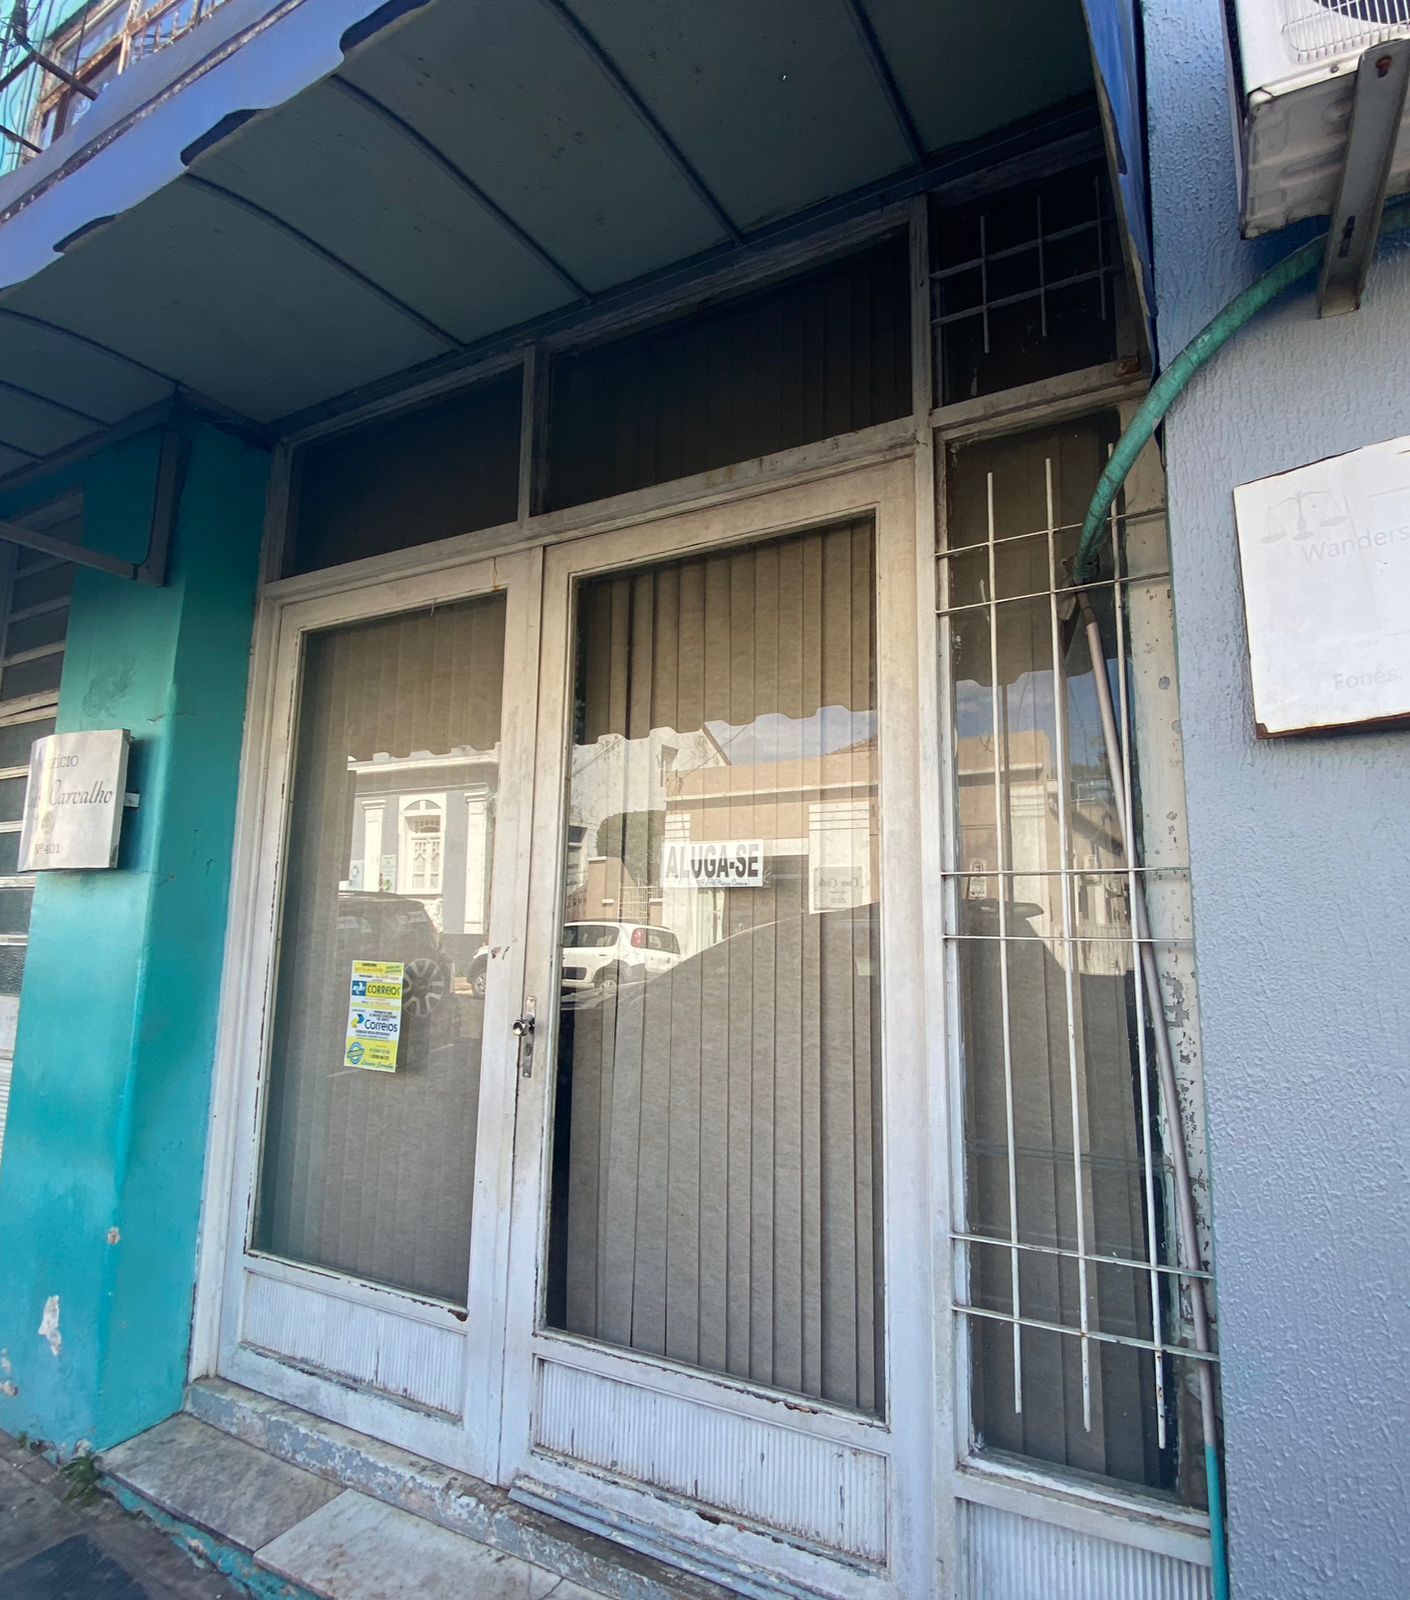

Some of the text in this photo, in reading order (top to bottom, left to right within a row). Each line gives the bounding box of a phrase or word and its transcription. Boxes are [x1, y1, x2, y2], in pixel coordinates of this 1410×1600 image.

[50, 779, 113, 805] Carvalho
[664, 843, 760, 879] ALUGA-SE
[364, 1019, 398, 1033] Correios
